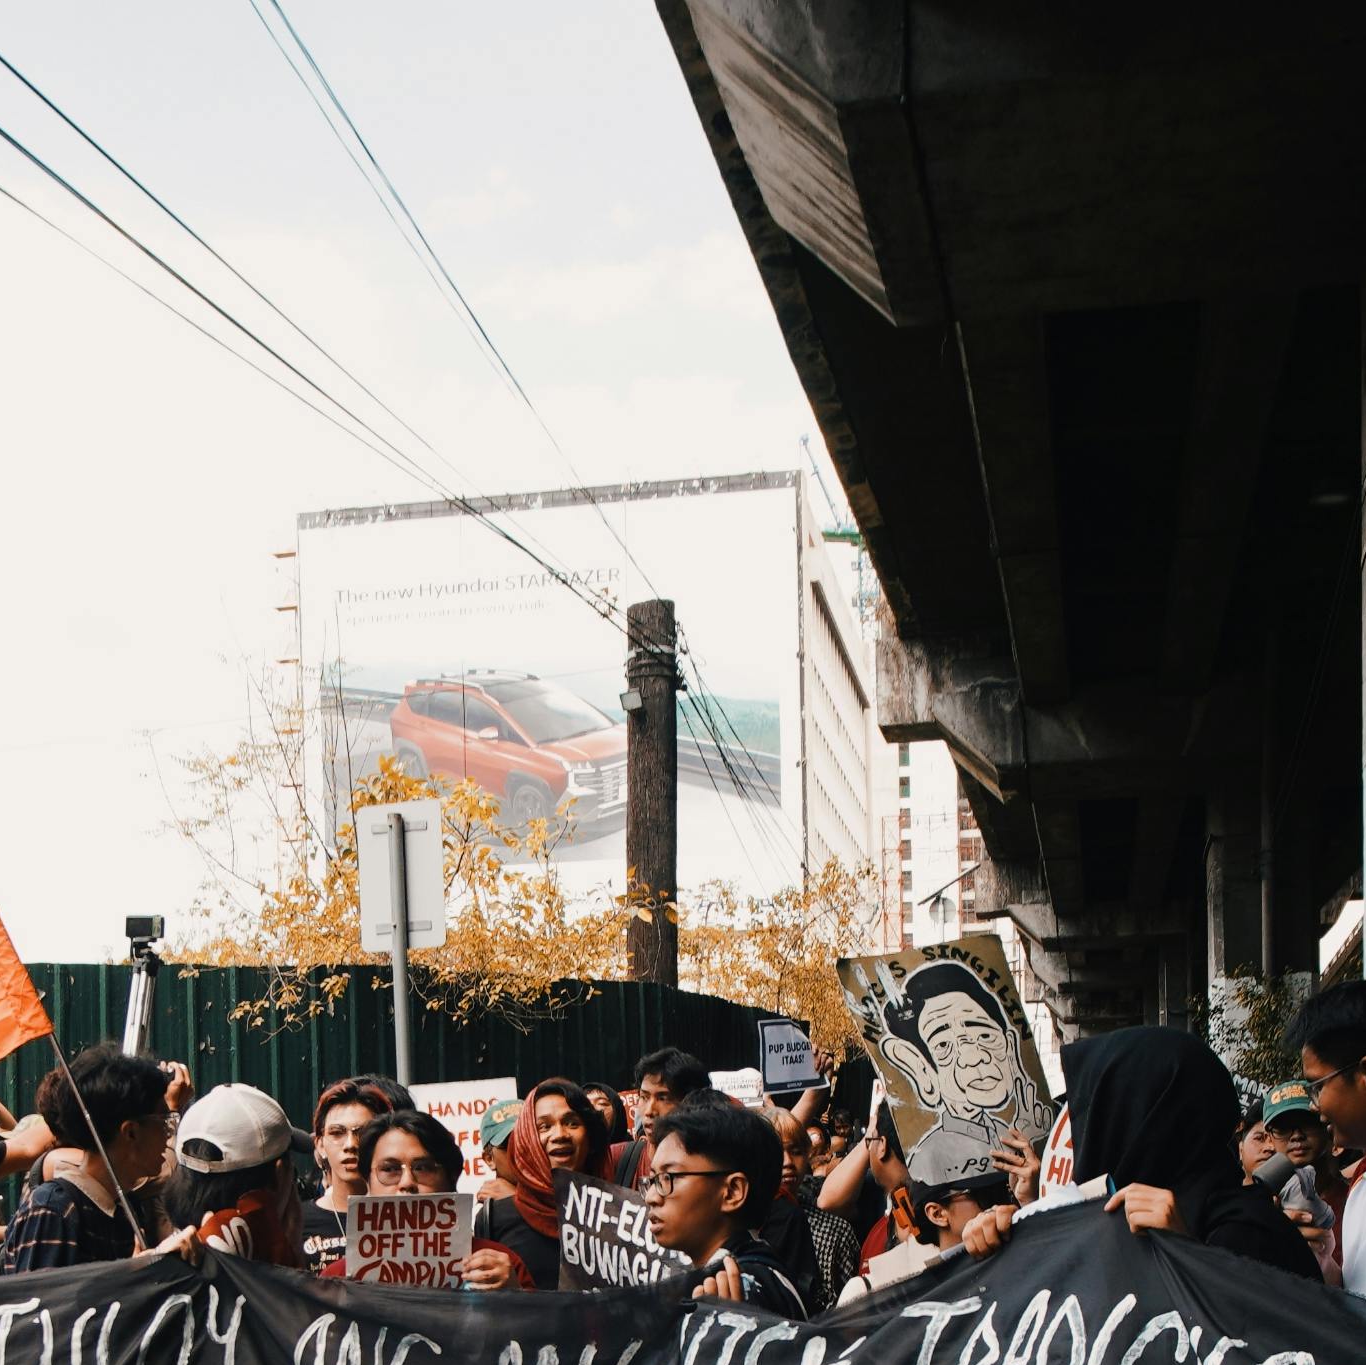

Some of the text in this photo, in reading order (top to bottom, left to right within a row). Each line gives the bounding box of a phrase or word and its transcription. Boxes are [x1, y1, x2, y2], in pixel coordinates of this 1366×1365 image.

[335, 567, 621, 605] The new Hyundai STARGAZER
[768, 1043, 784, 1054] PUP
[357, 1198, 457, 1232] HANDS
[358, 1232, 452, 1258] OFF THE
